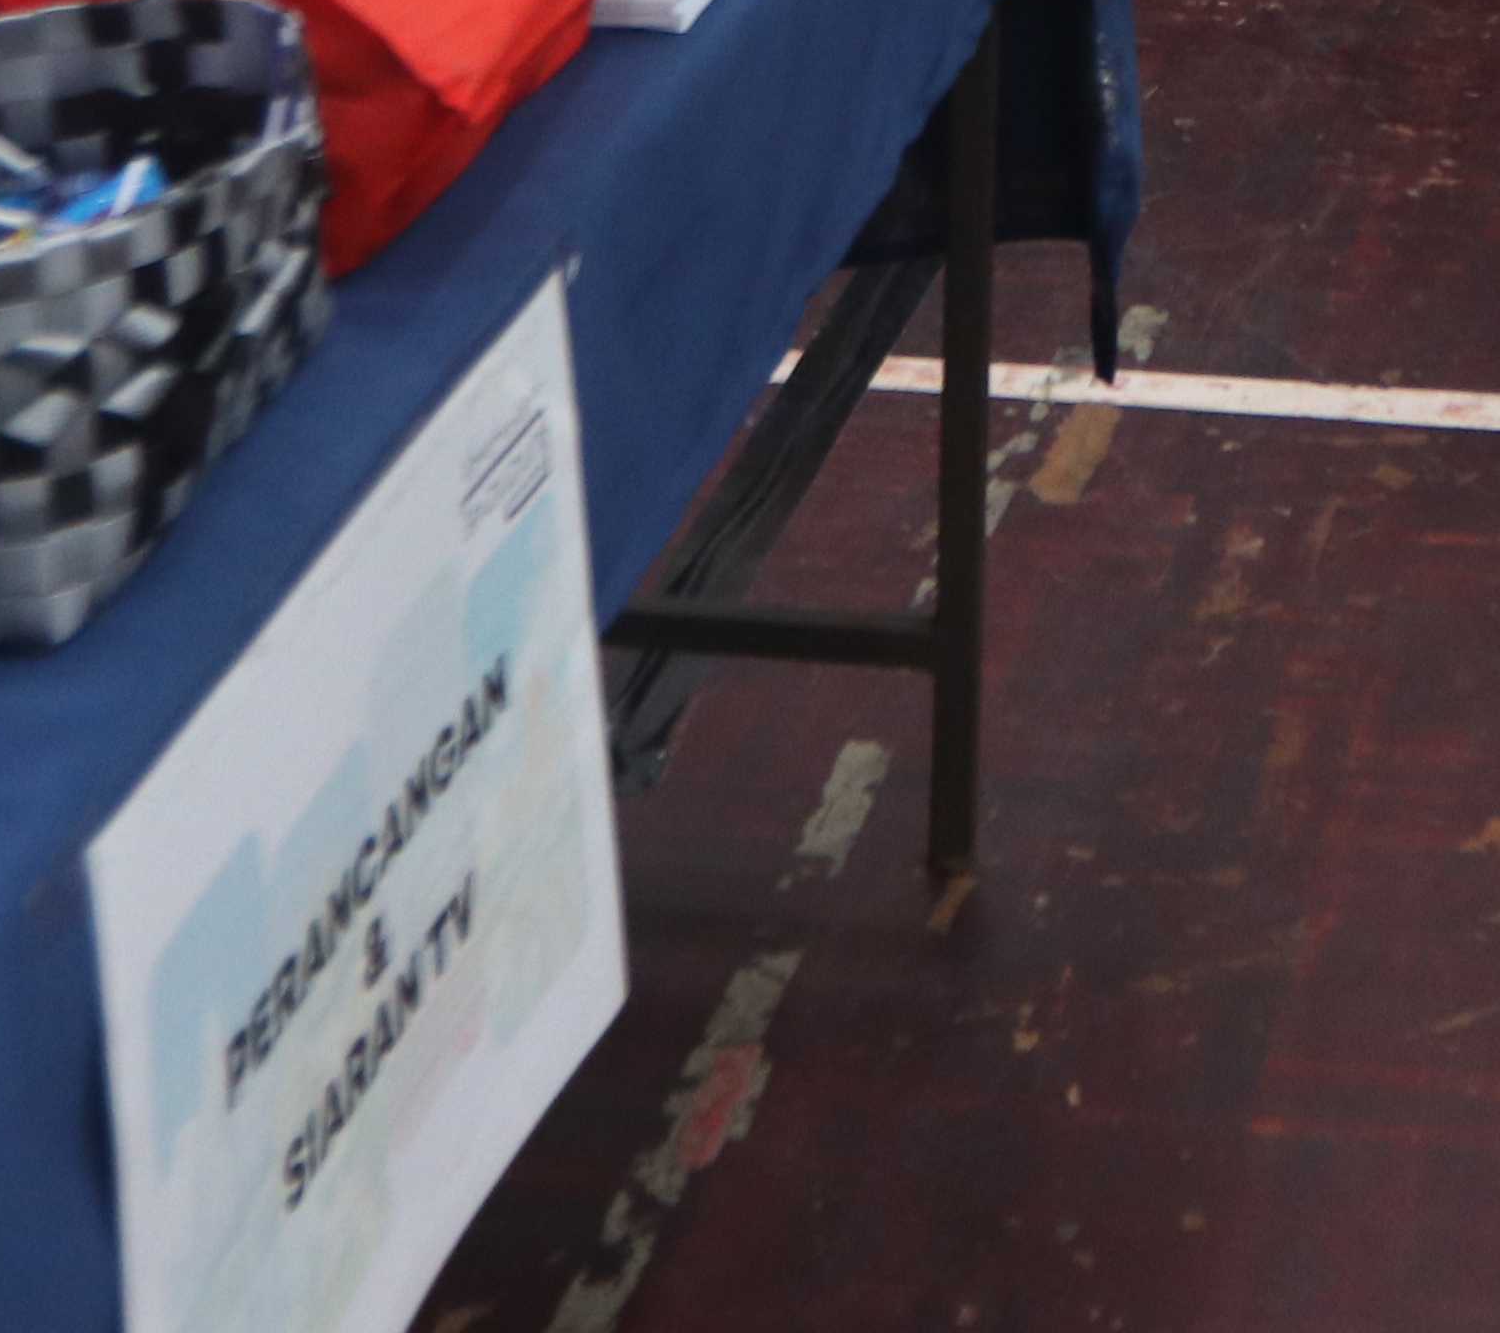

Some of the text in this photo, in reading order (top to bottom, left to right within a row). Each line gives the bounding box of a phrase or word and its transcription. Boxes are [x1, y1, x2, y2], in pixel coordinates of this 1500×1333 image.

[224, 651, 510, 1116] PERANCANGAN
[284, 867, 476, 1214] SIARAN TV
[362, 913, 391, 993] &
